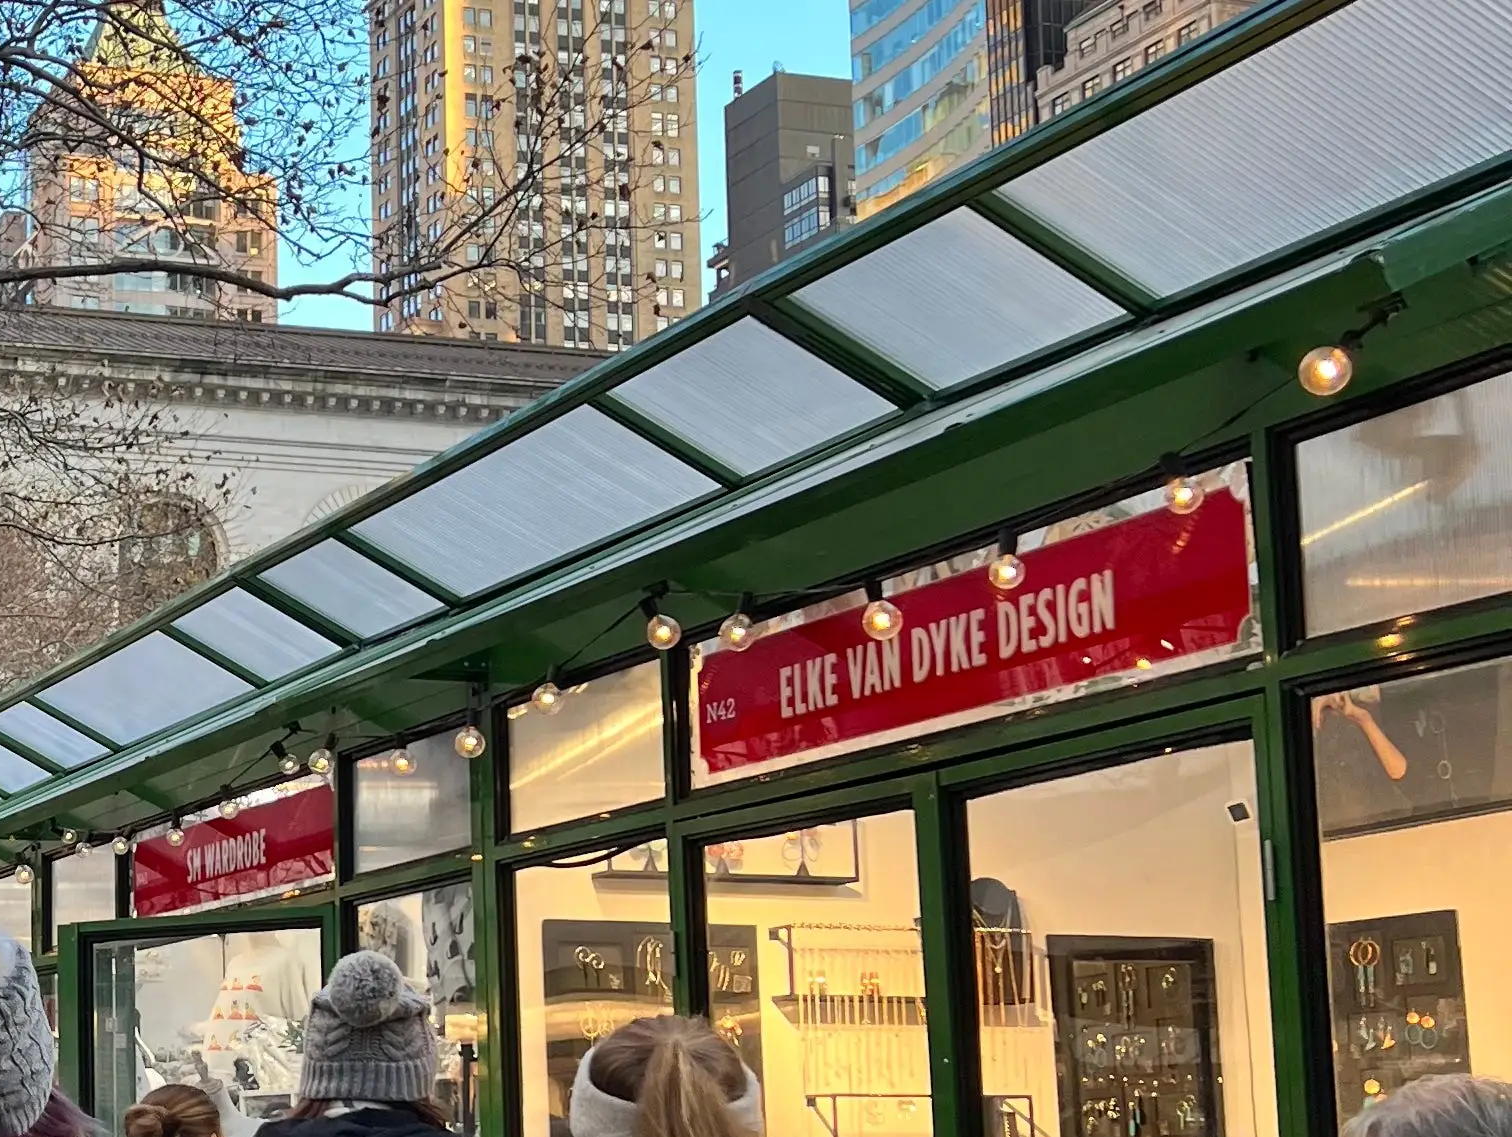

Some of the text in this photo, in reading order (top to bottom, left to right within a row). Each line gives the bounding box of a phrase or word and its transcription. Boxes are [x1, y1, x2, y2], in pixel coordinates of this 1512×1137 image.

[779, 569, 1116, 719] ELKE VAN DYKE DESIGN
[705, 698, 736, 724] N42
[186, 828, 266, 883] SM WARDROBE
